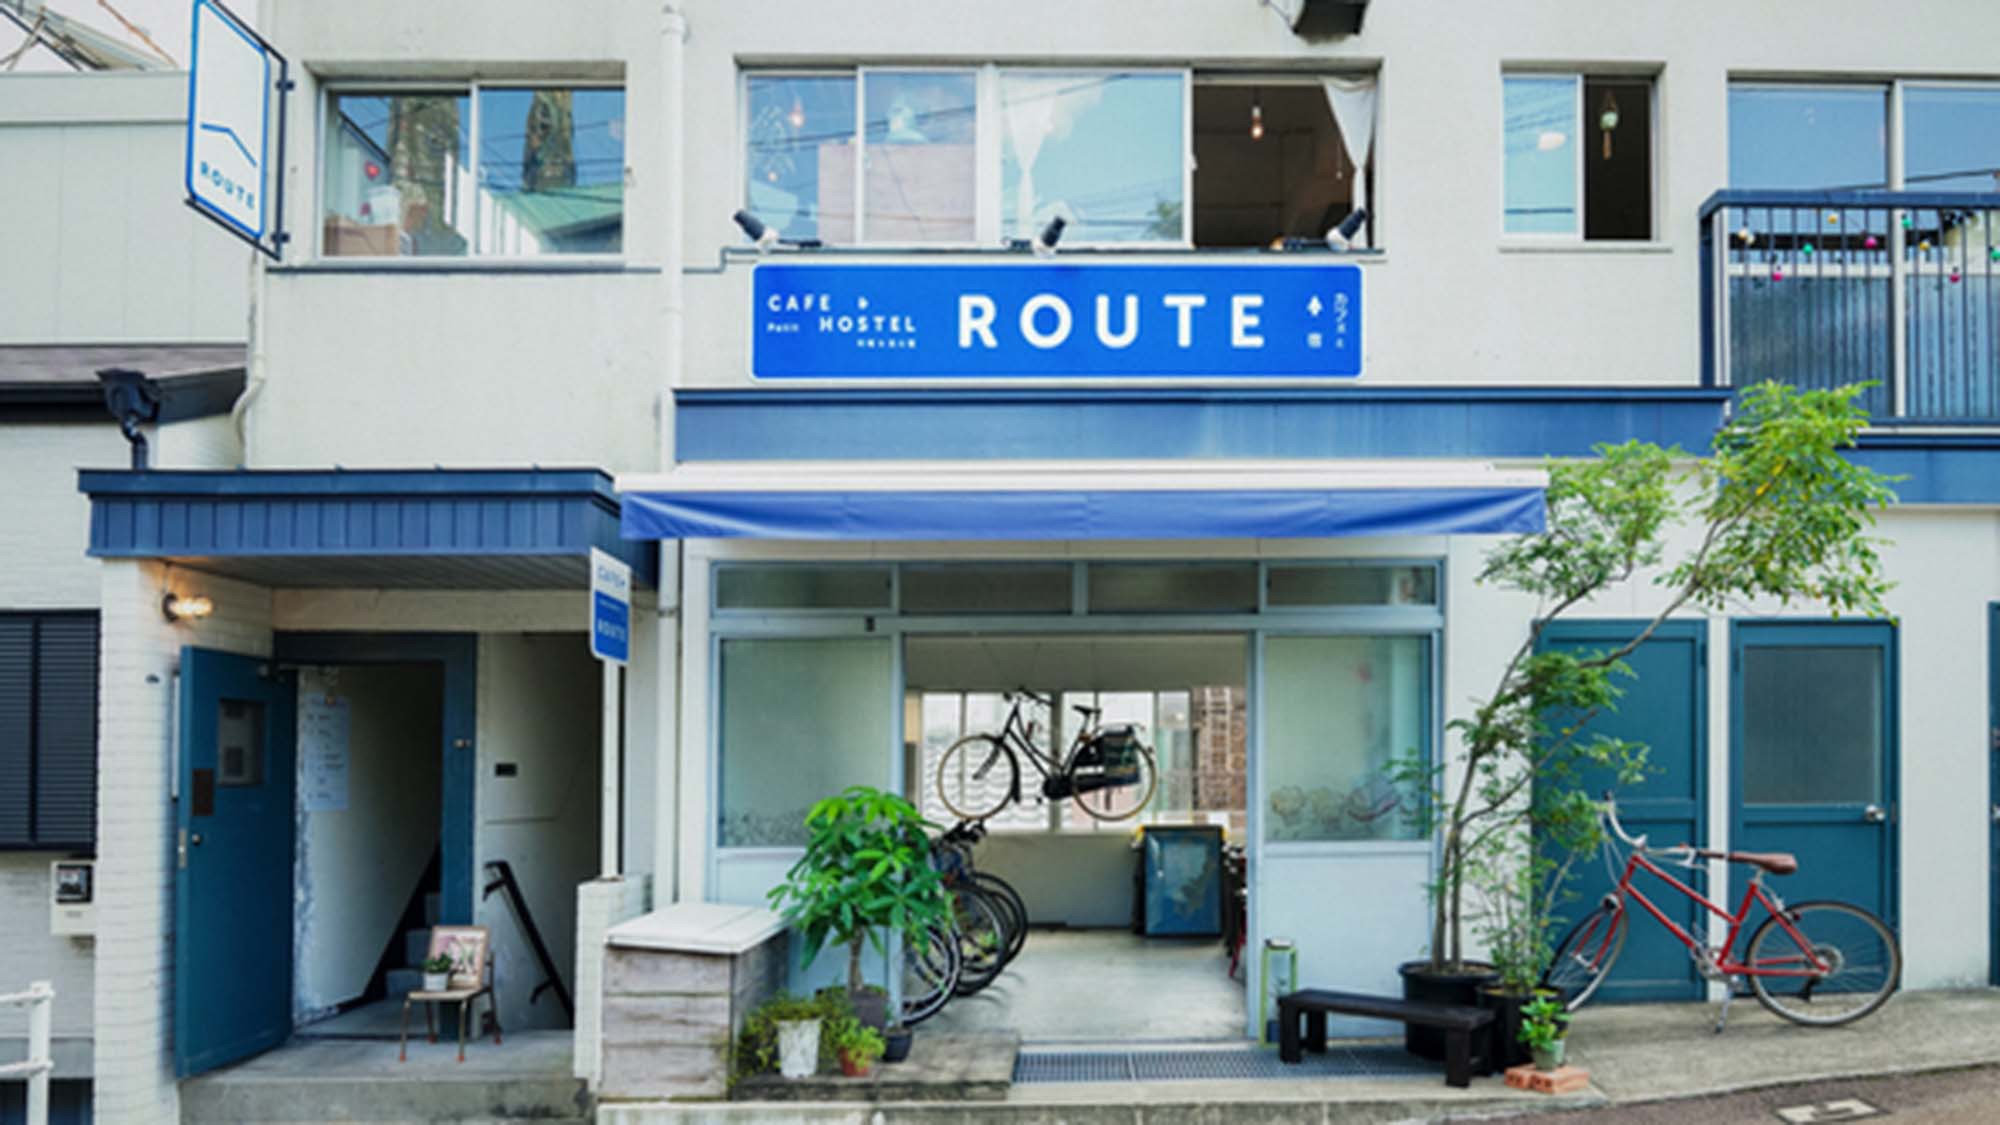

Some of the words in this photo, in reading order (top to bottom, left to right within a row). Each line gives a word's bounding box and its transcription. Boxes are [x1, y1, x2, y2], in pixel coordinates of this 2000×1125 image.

[200, 160, 255, 210] ROUTE
[767, 294, 831, 311] CAFE
[819, 315, 916, 333] HOSTEL
[958, 293, 1265, 349] ROUTE
